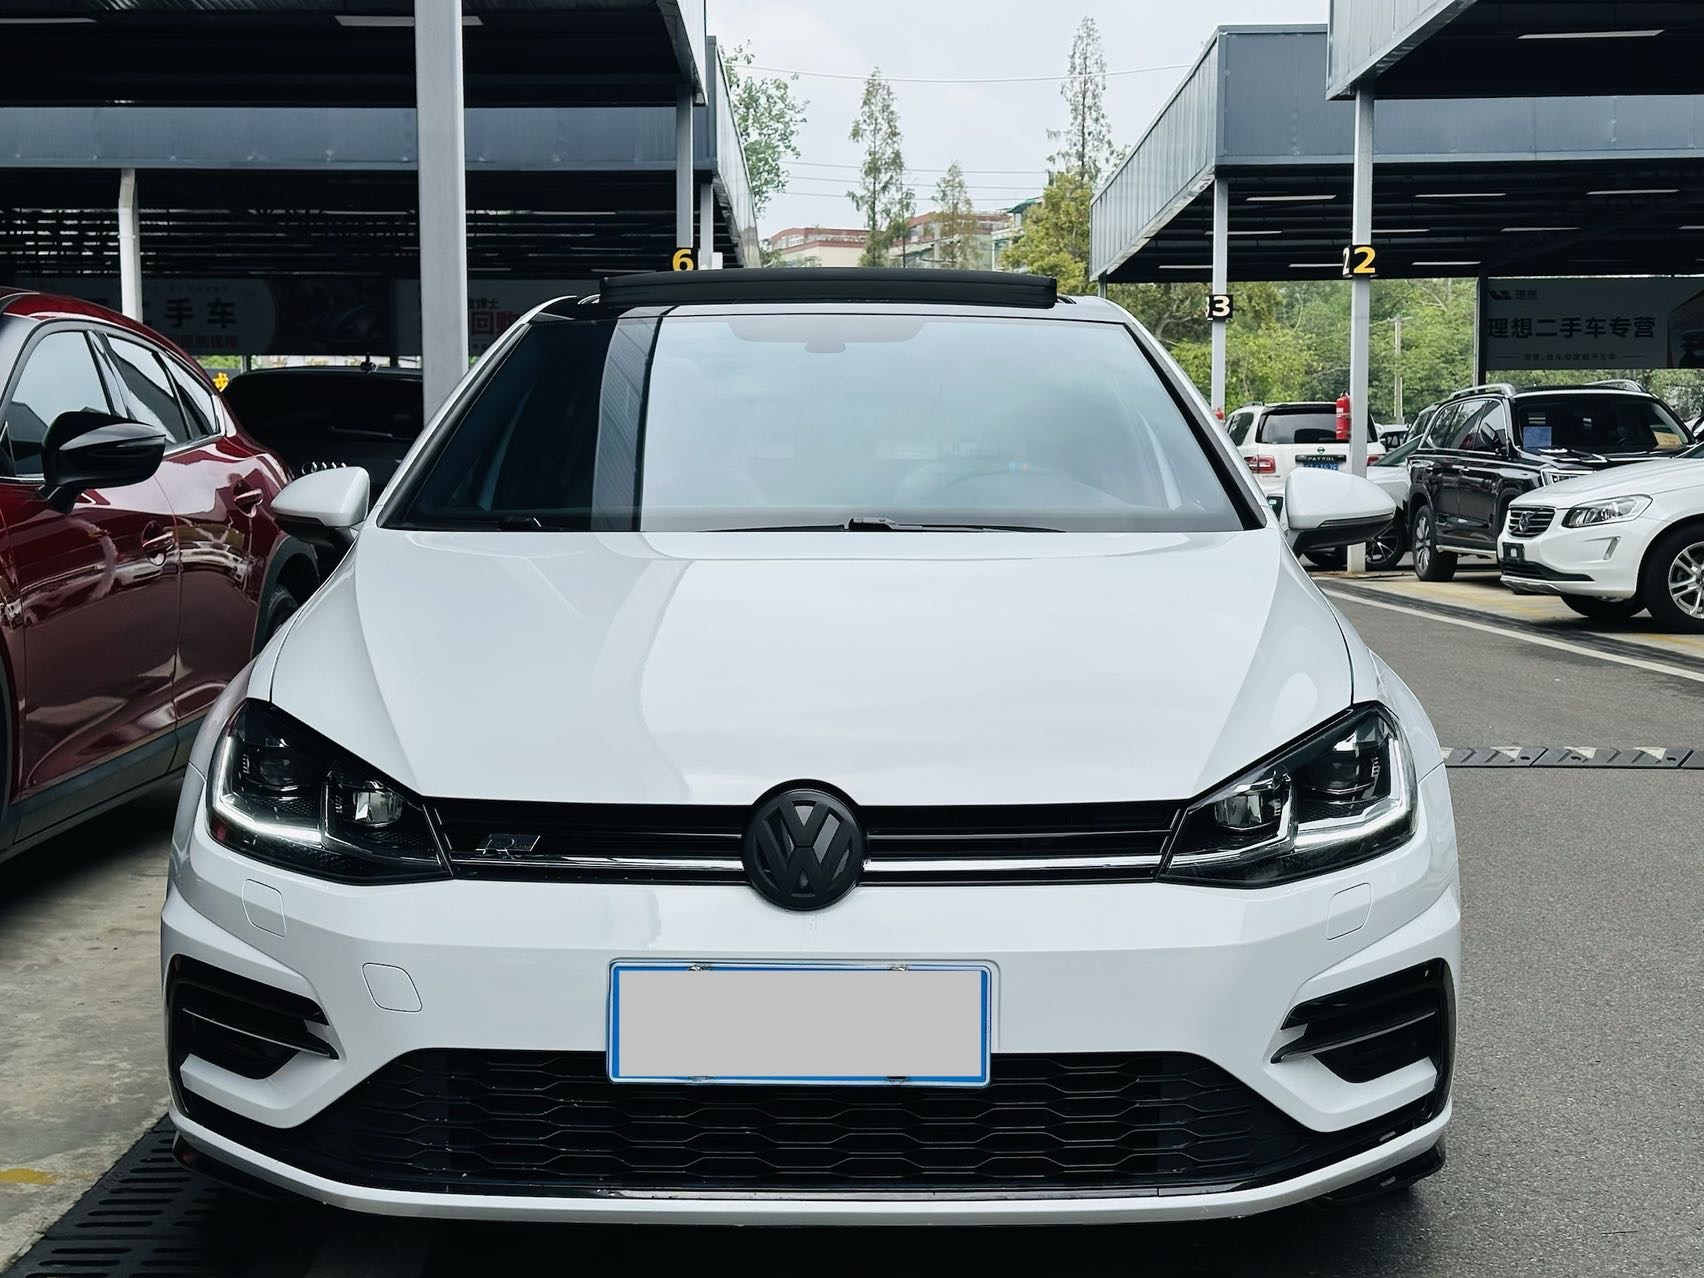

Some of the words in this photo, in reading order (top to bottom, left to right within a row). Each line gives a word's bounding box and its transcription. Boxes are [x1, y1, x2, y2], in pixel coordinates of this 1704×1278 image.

[672, 248, 694, 272] 6
[1353, 246, 1376, 274] 2
[143, 297, 236, 329] 手车
[1212, 295, 1230, 317] 3
[1488, 316, 1656, 339] 理想二手车专营
